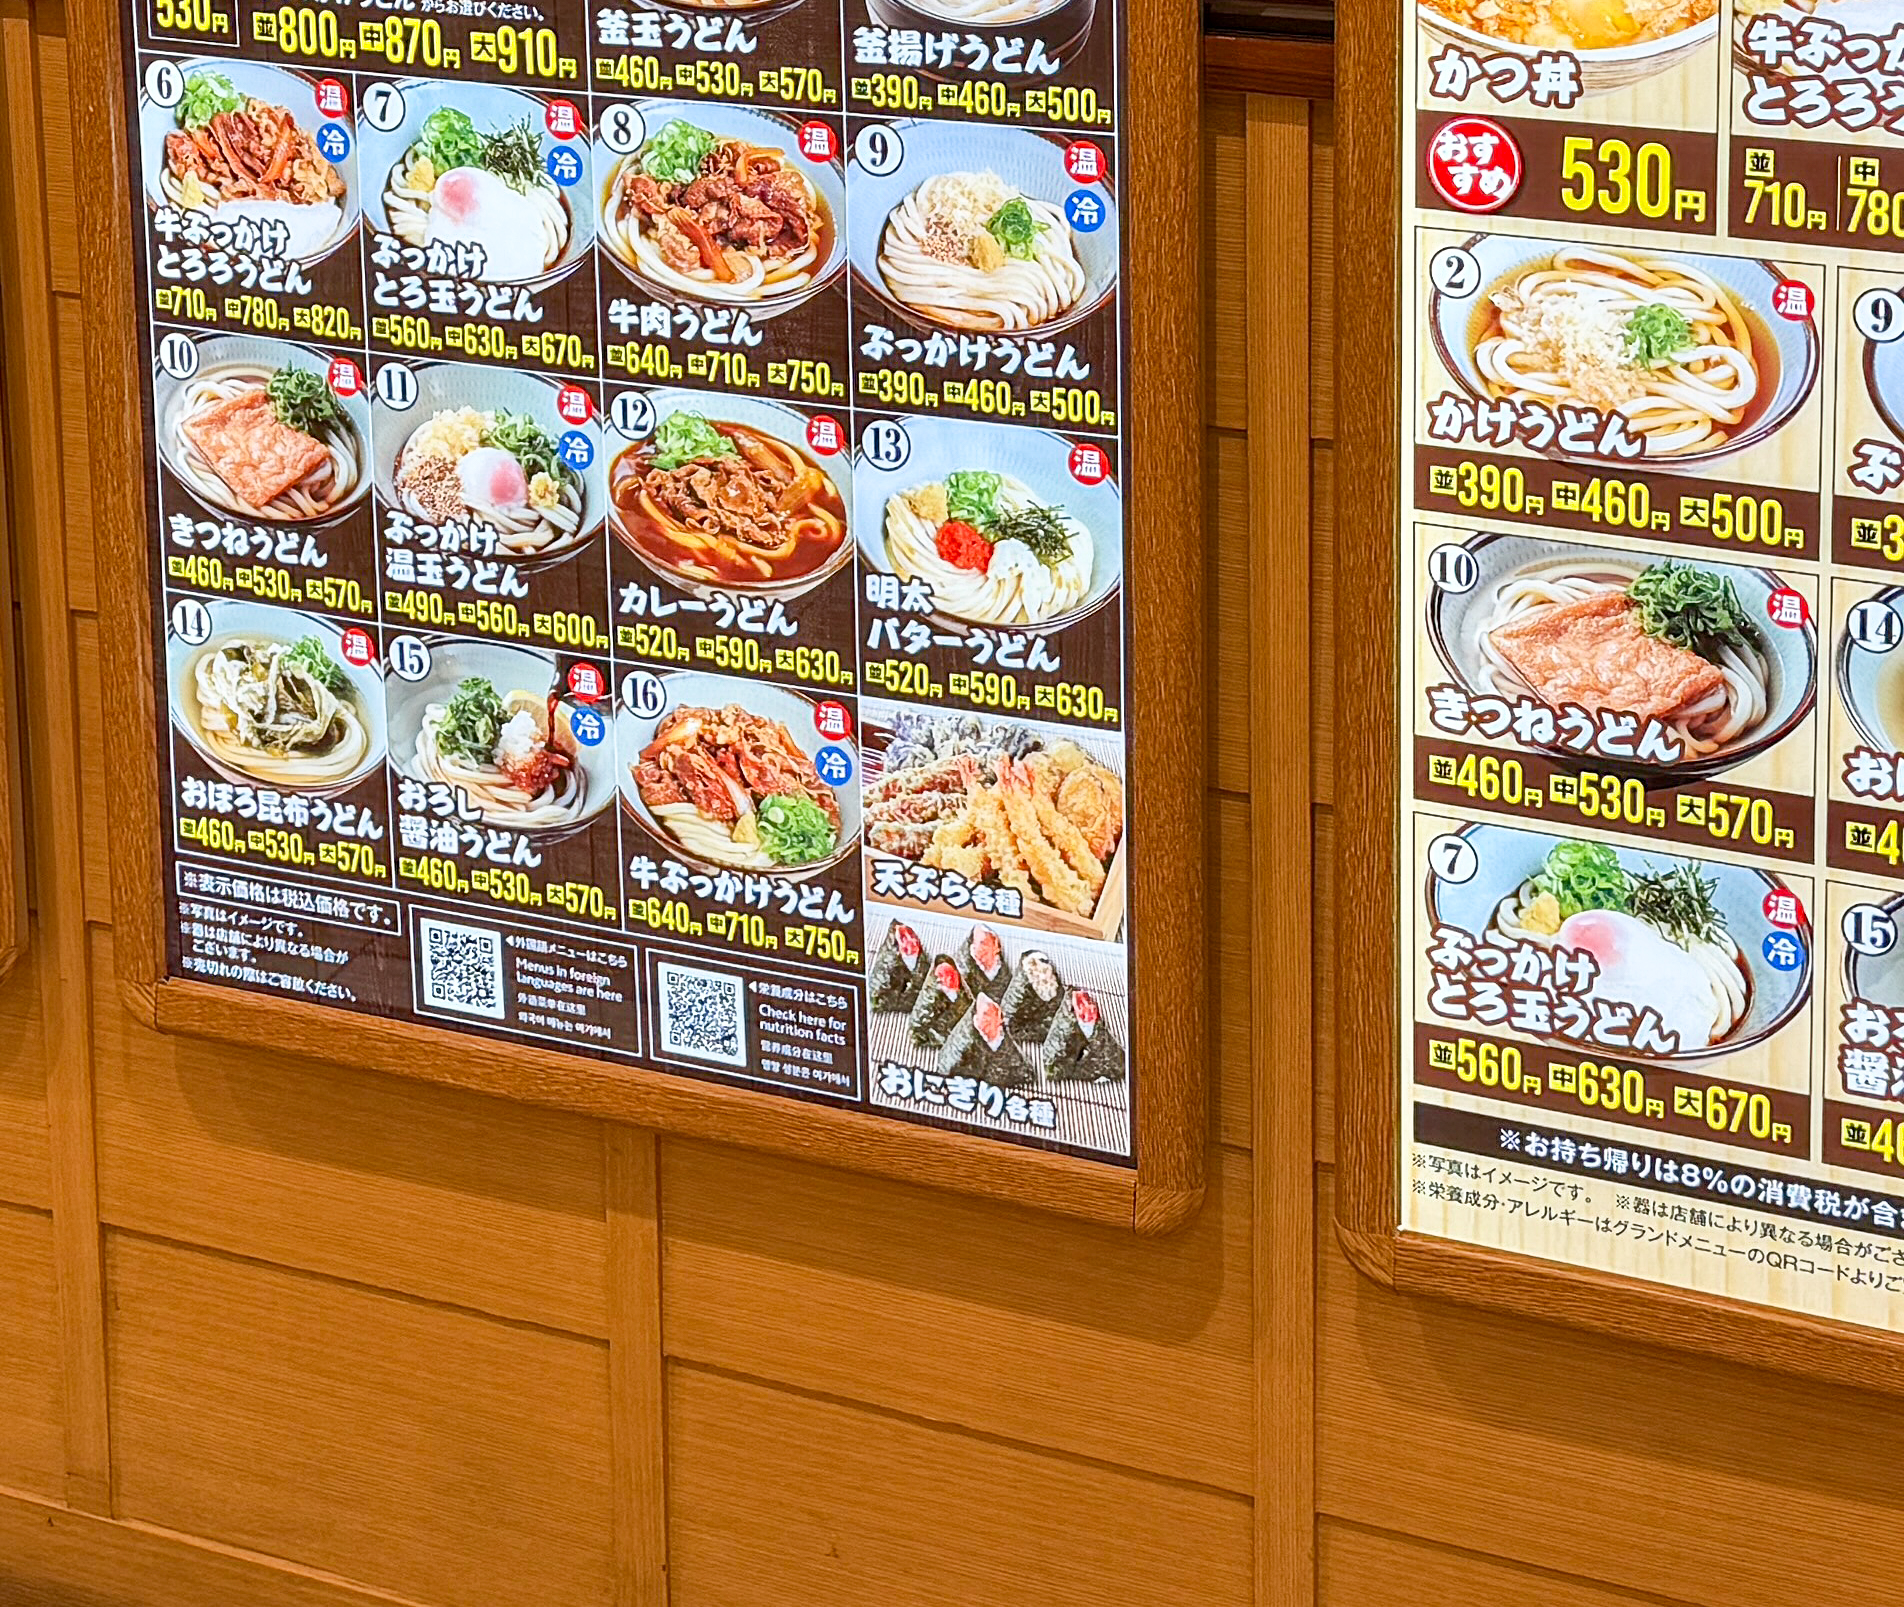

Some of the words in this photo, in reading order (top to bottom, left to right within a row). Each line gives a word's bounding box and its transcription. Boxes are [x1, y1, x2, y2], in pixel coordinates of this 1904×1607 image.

[596, 7, 757, 56] 釜玉うどん
[852, 25, 1061, 76] 釜揚げうどん
[1433, 50, 1582, 104] かつ丼
[1563, 136, 1707, 223] 530円
[154, 204, 289, 252] 牛ぶっかけ
[156, 244, 313, 295] とろろうどん
[370, 234, 488, 280] ぶっかけ
[372, 272, 545, 325] とろ玉うどん
[607, 298, 763, 348] 牛肉うどん
[859, 325, 1091, 383] ぶっかけうどん
[1430, 396, 1644, 457] かけうどん
[167, 511, 328, 569] きつねうどん
[383, 509, 499, 555] ぶっかけ
[384, 545, 530, 599] 温玉うどん
[864, 575, 933, 615] 明太
[618, 582, 799, 638] カレーうどん
[867, 618, 1061, 673] バターうどん
[1430, 687, 1683, 764] きつねうどん
[180, 777, 384, 843] おぼろ昆布うどん
[398, 779, 484, 822] おろし
[399, 813, 543, 869] 醤油うどん
[629, 855, 855, 926] 牛ぶっかけうどん
[871, 860, 1025, 918] 天ぷら各種
[516, 956, 555, 974] Menus
[556, 965, 567, 978] in
[570, 967, 611, 986] foreign
[516, 971, 574, 993] languages
[575, 986, 594, 997] are
[596, 986, 623, 1003] here
[1432, 932, 1596, 990] ぶっかけ
[758, 1003, 796, 1022] Check
[798, 1011, 827, 1028] here
[828, 1016, 847, 1031] for
[759, 1020, 814, 1040] nutrition
[815, 1028, 846, 1046] facts
[1430, 975, 1681, 1052] とろ玉うどん
[878, 1061, 1058, 1130] おにぎり各種
[1412, 1153, 1592, 1204] ※写真はイメージです。
